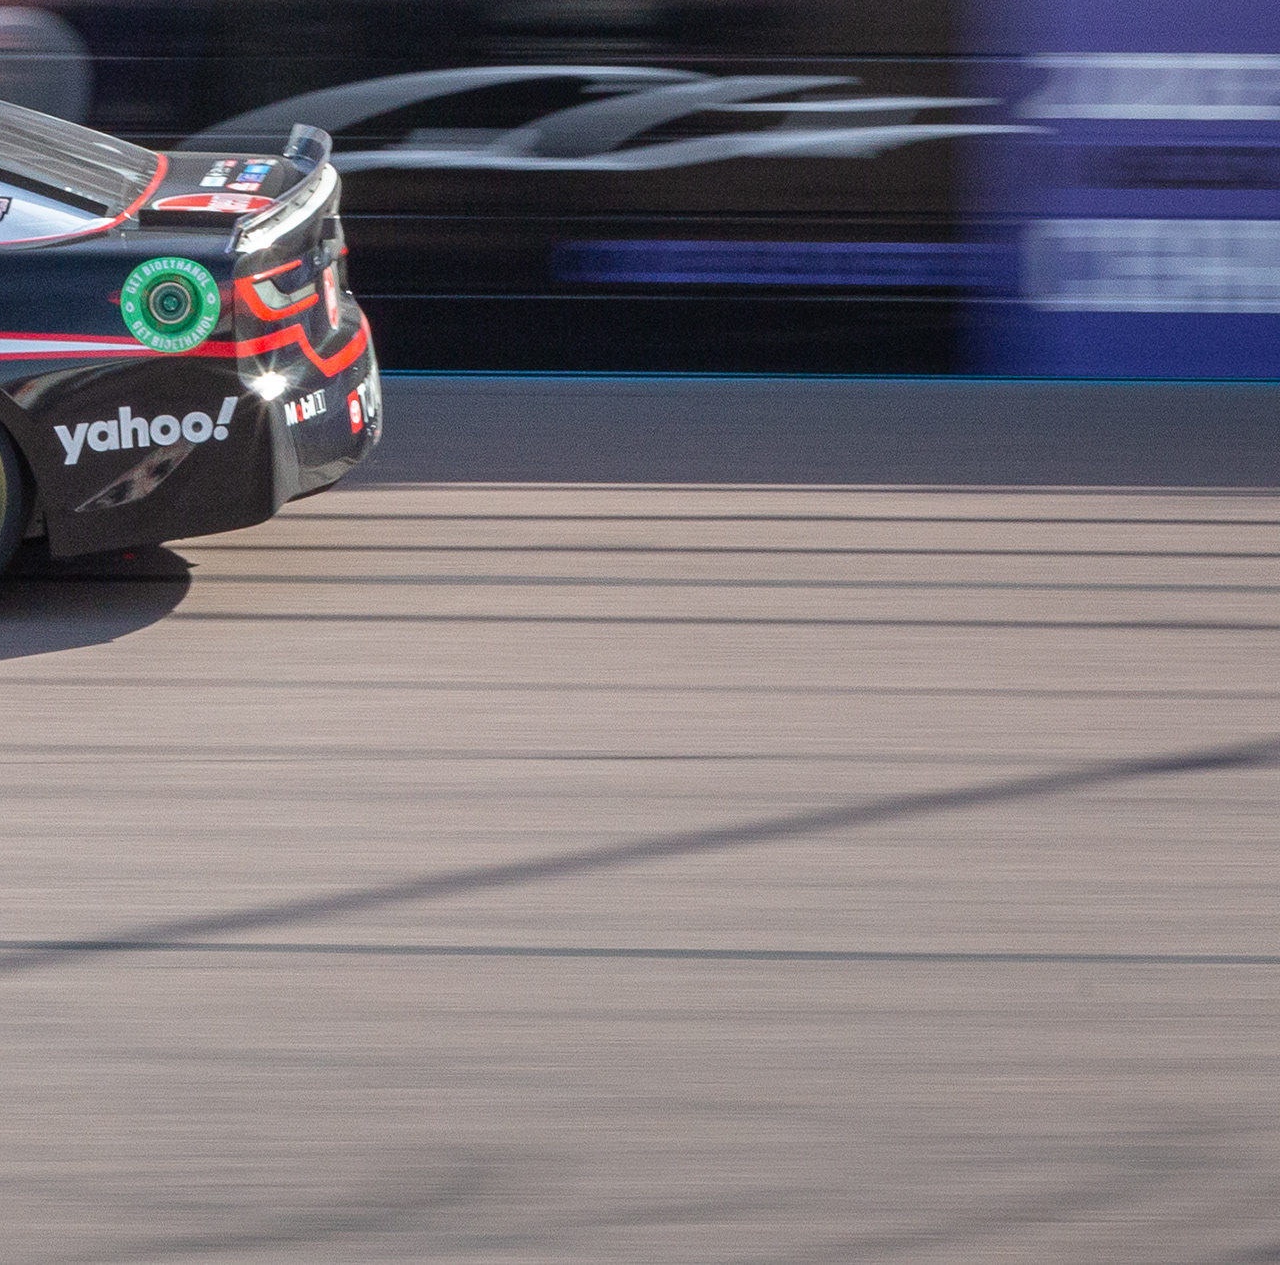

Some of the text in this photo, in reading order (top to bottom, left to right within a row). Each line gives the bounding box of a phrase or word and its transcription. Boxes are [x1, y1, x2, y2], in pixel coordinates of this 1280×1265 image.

[126, 260, 210, 294] GET BIOETHANOL
[132, 315, 214, 350] GET BIOETHANOL
[53, 396, 239, 466] yahoo!
